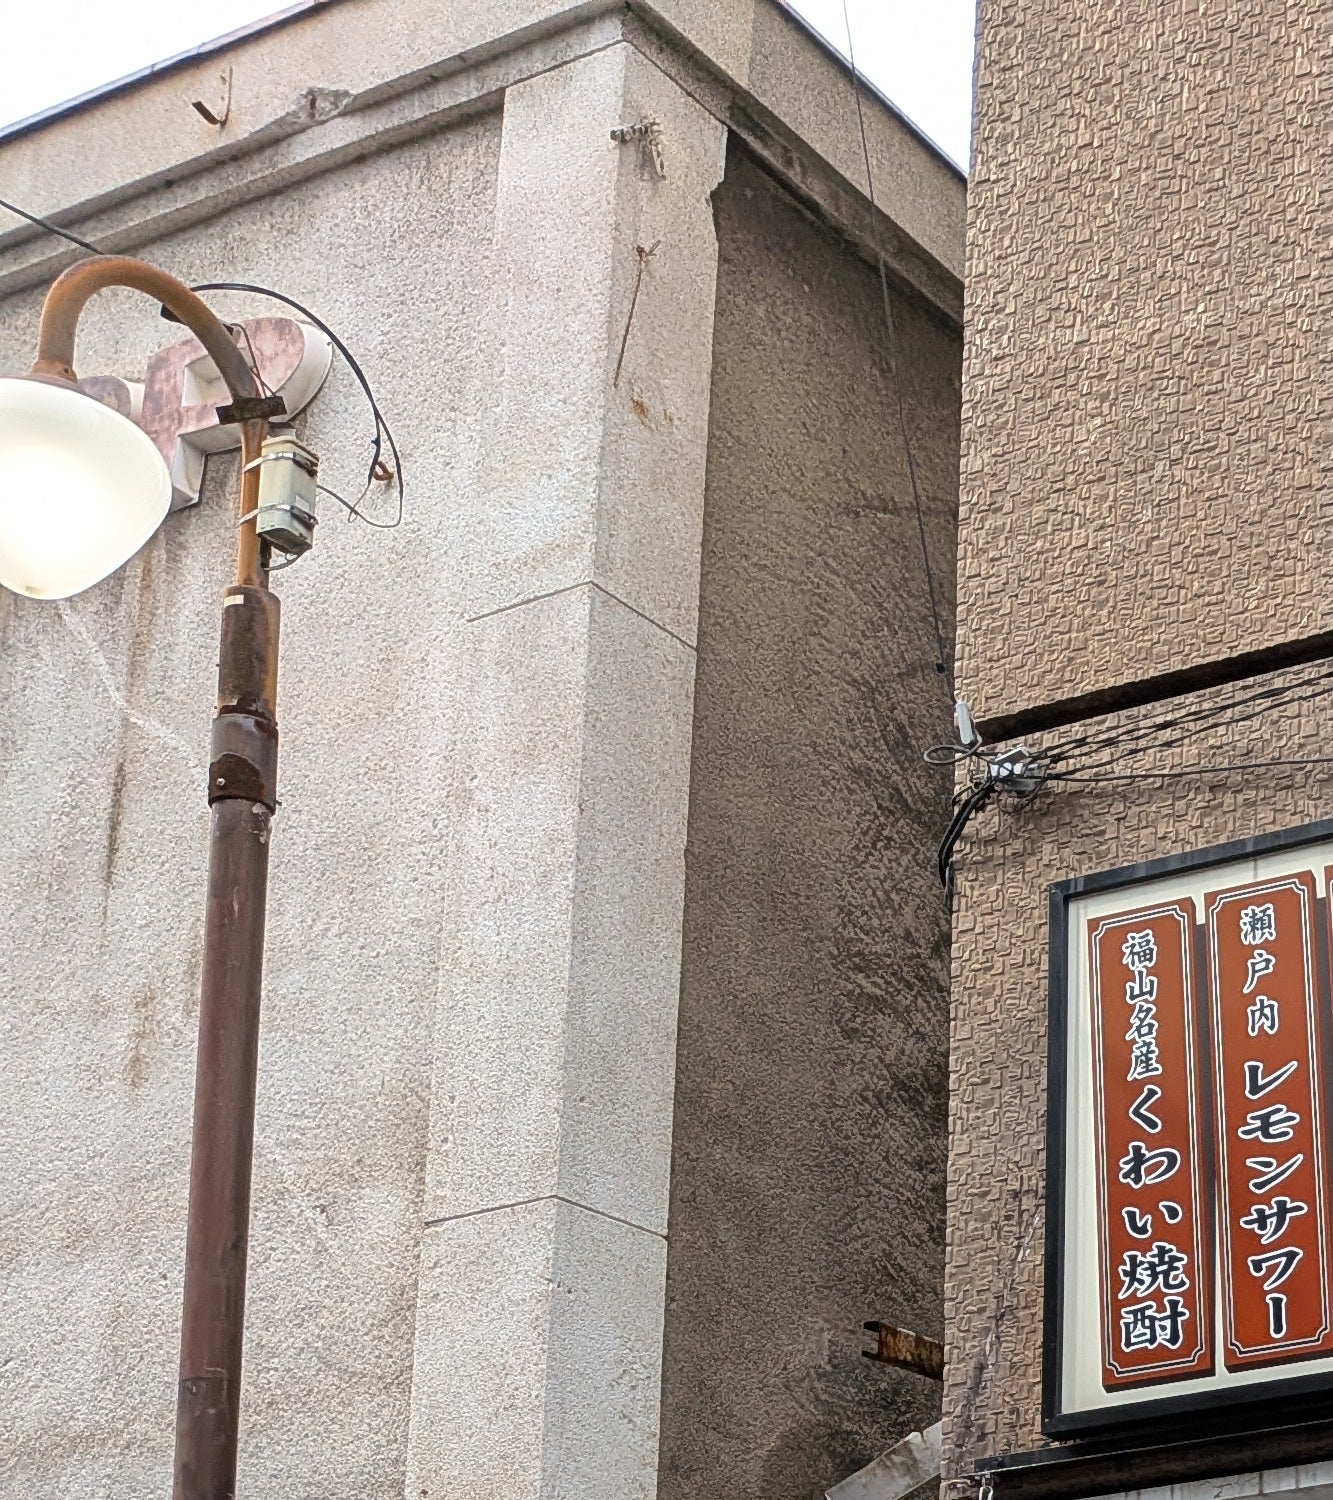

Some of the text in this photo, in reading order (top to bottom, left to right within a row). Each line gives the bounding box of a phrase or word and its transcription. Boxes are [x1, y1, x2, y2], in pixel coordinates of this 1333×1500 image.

[1119, 929, 1188, 1353] 福山名産 くわい焼酎
[1238, 903, 1306, 1338] 瀬戸内 レモンサワー
